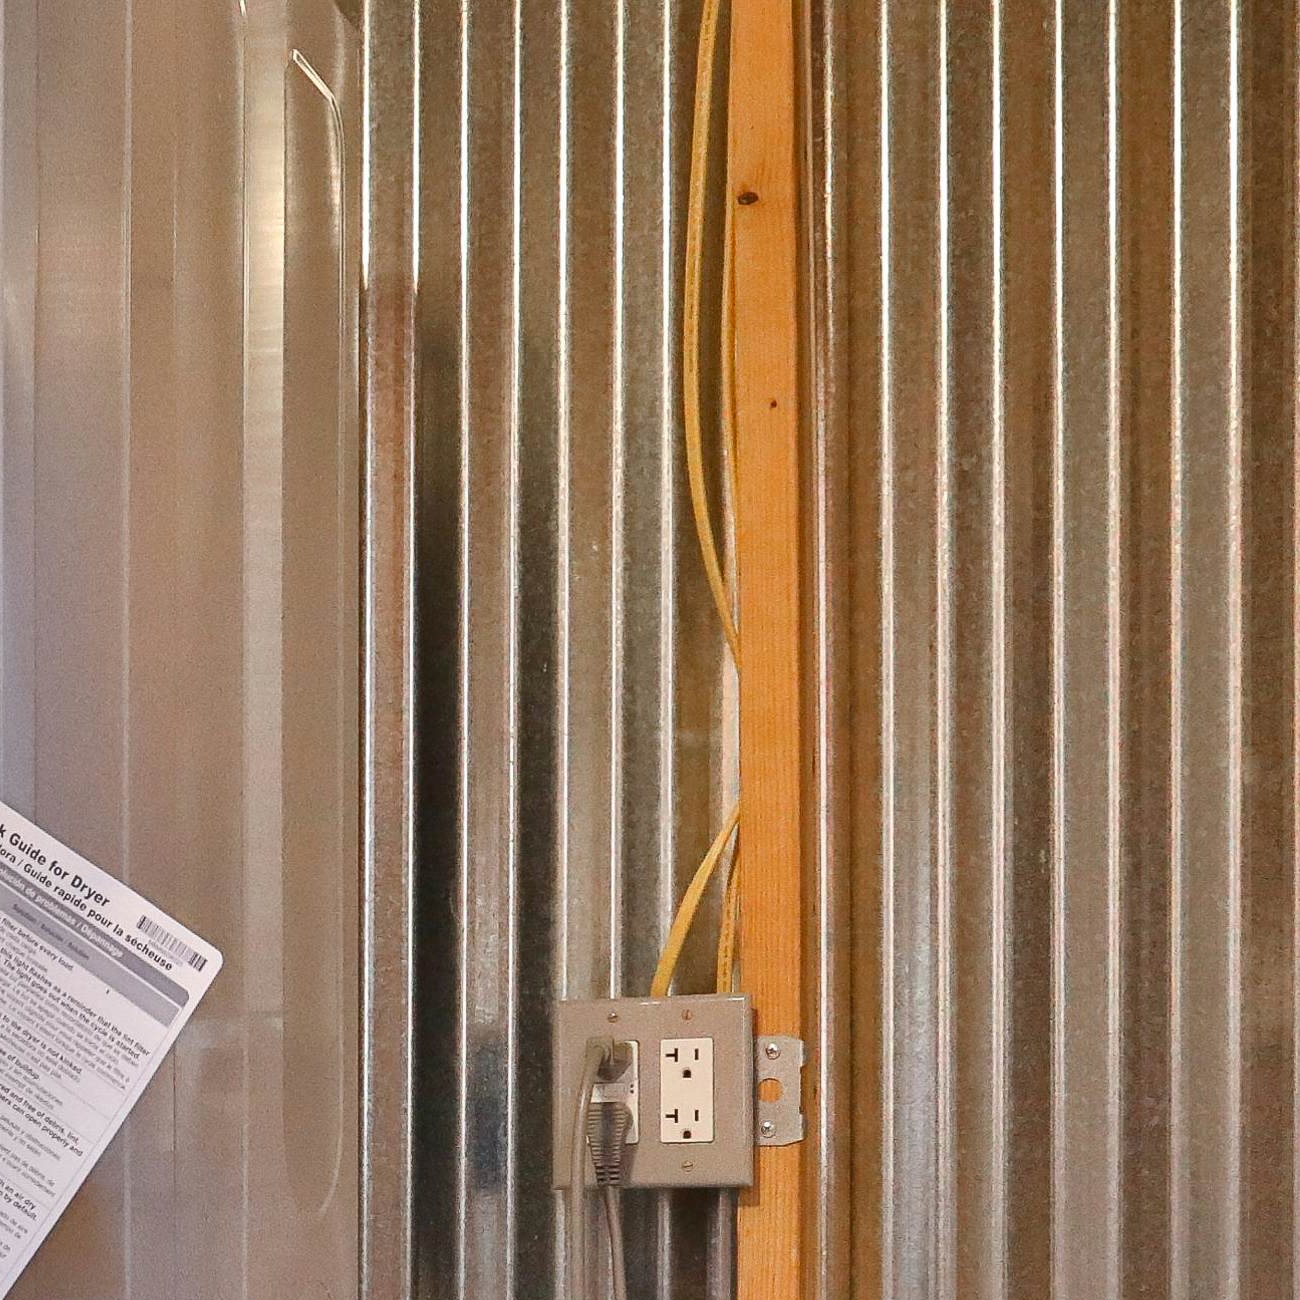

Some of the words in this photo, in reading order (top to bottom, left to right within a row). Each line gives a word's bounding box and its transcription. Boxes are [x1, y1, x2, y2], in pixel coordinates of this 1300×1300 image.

[8, 832, 46, 865] Guide
[48, 860, 69, 880] for
[70, 874, 109, 906] Dryer
[23, 863, 52, 888] Guide
[52, 885, 87, 911] rapide
[86, 908, 112, 928] pour
[112, 923, 123, 936] la
